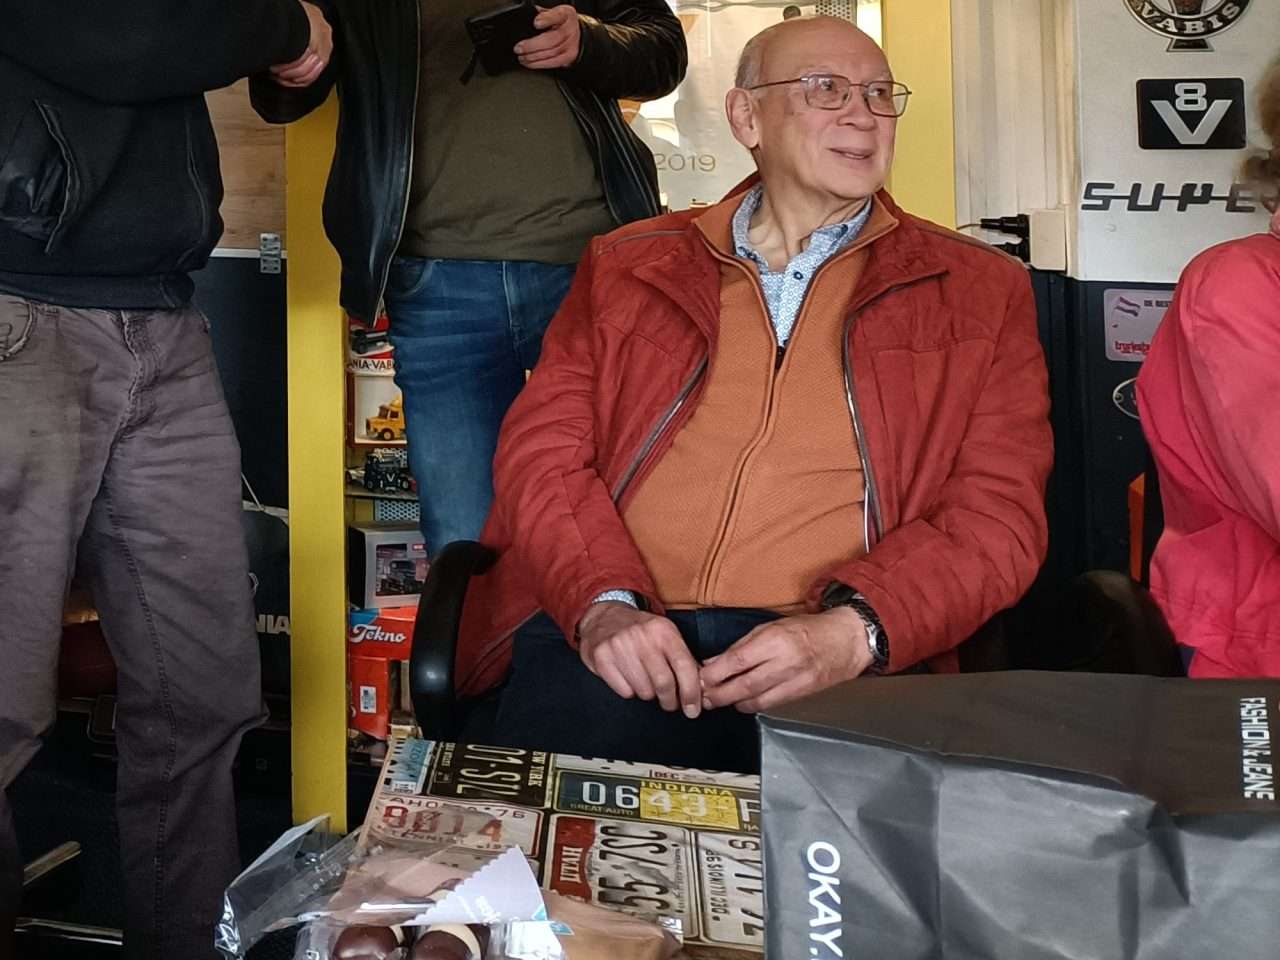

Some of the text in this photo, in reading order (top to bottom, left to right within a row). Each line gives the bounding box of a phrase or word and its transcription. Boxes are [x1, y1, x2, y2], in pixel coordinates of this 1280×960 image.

[1141, 2, 1241, 34] VABIS
[1081, 183, 1256, 212] SUPE
[256, 614, 290, 636] NIA
[350, 623, 407, 643] Tekno
[1240, 696, 1271, 748] FASHION
[531, 751, 547, 765] EW
[640, 780, 733, 797] INDIANA
[559, 847, 584, 883] UTAH
[708, 862, 728, 897] ILLINOIS
